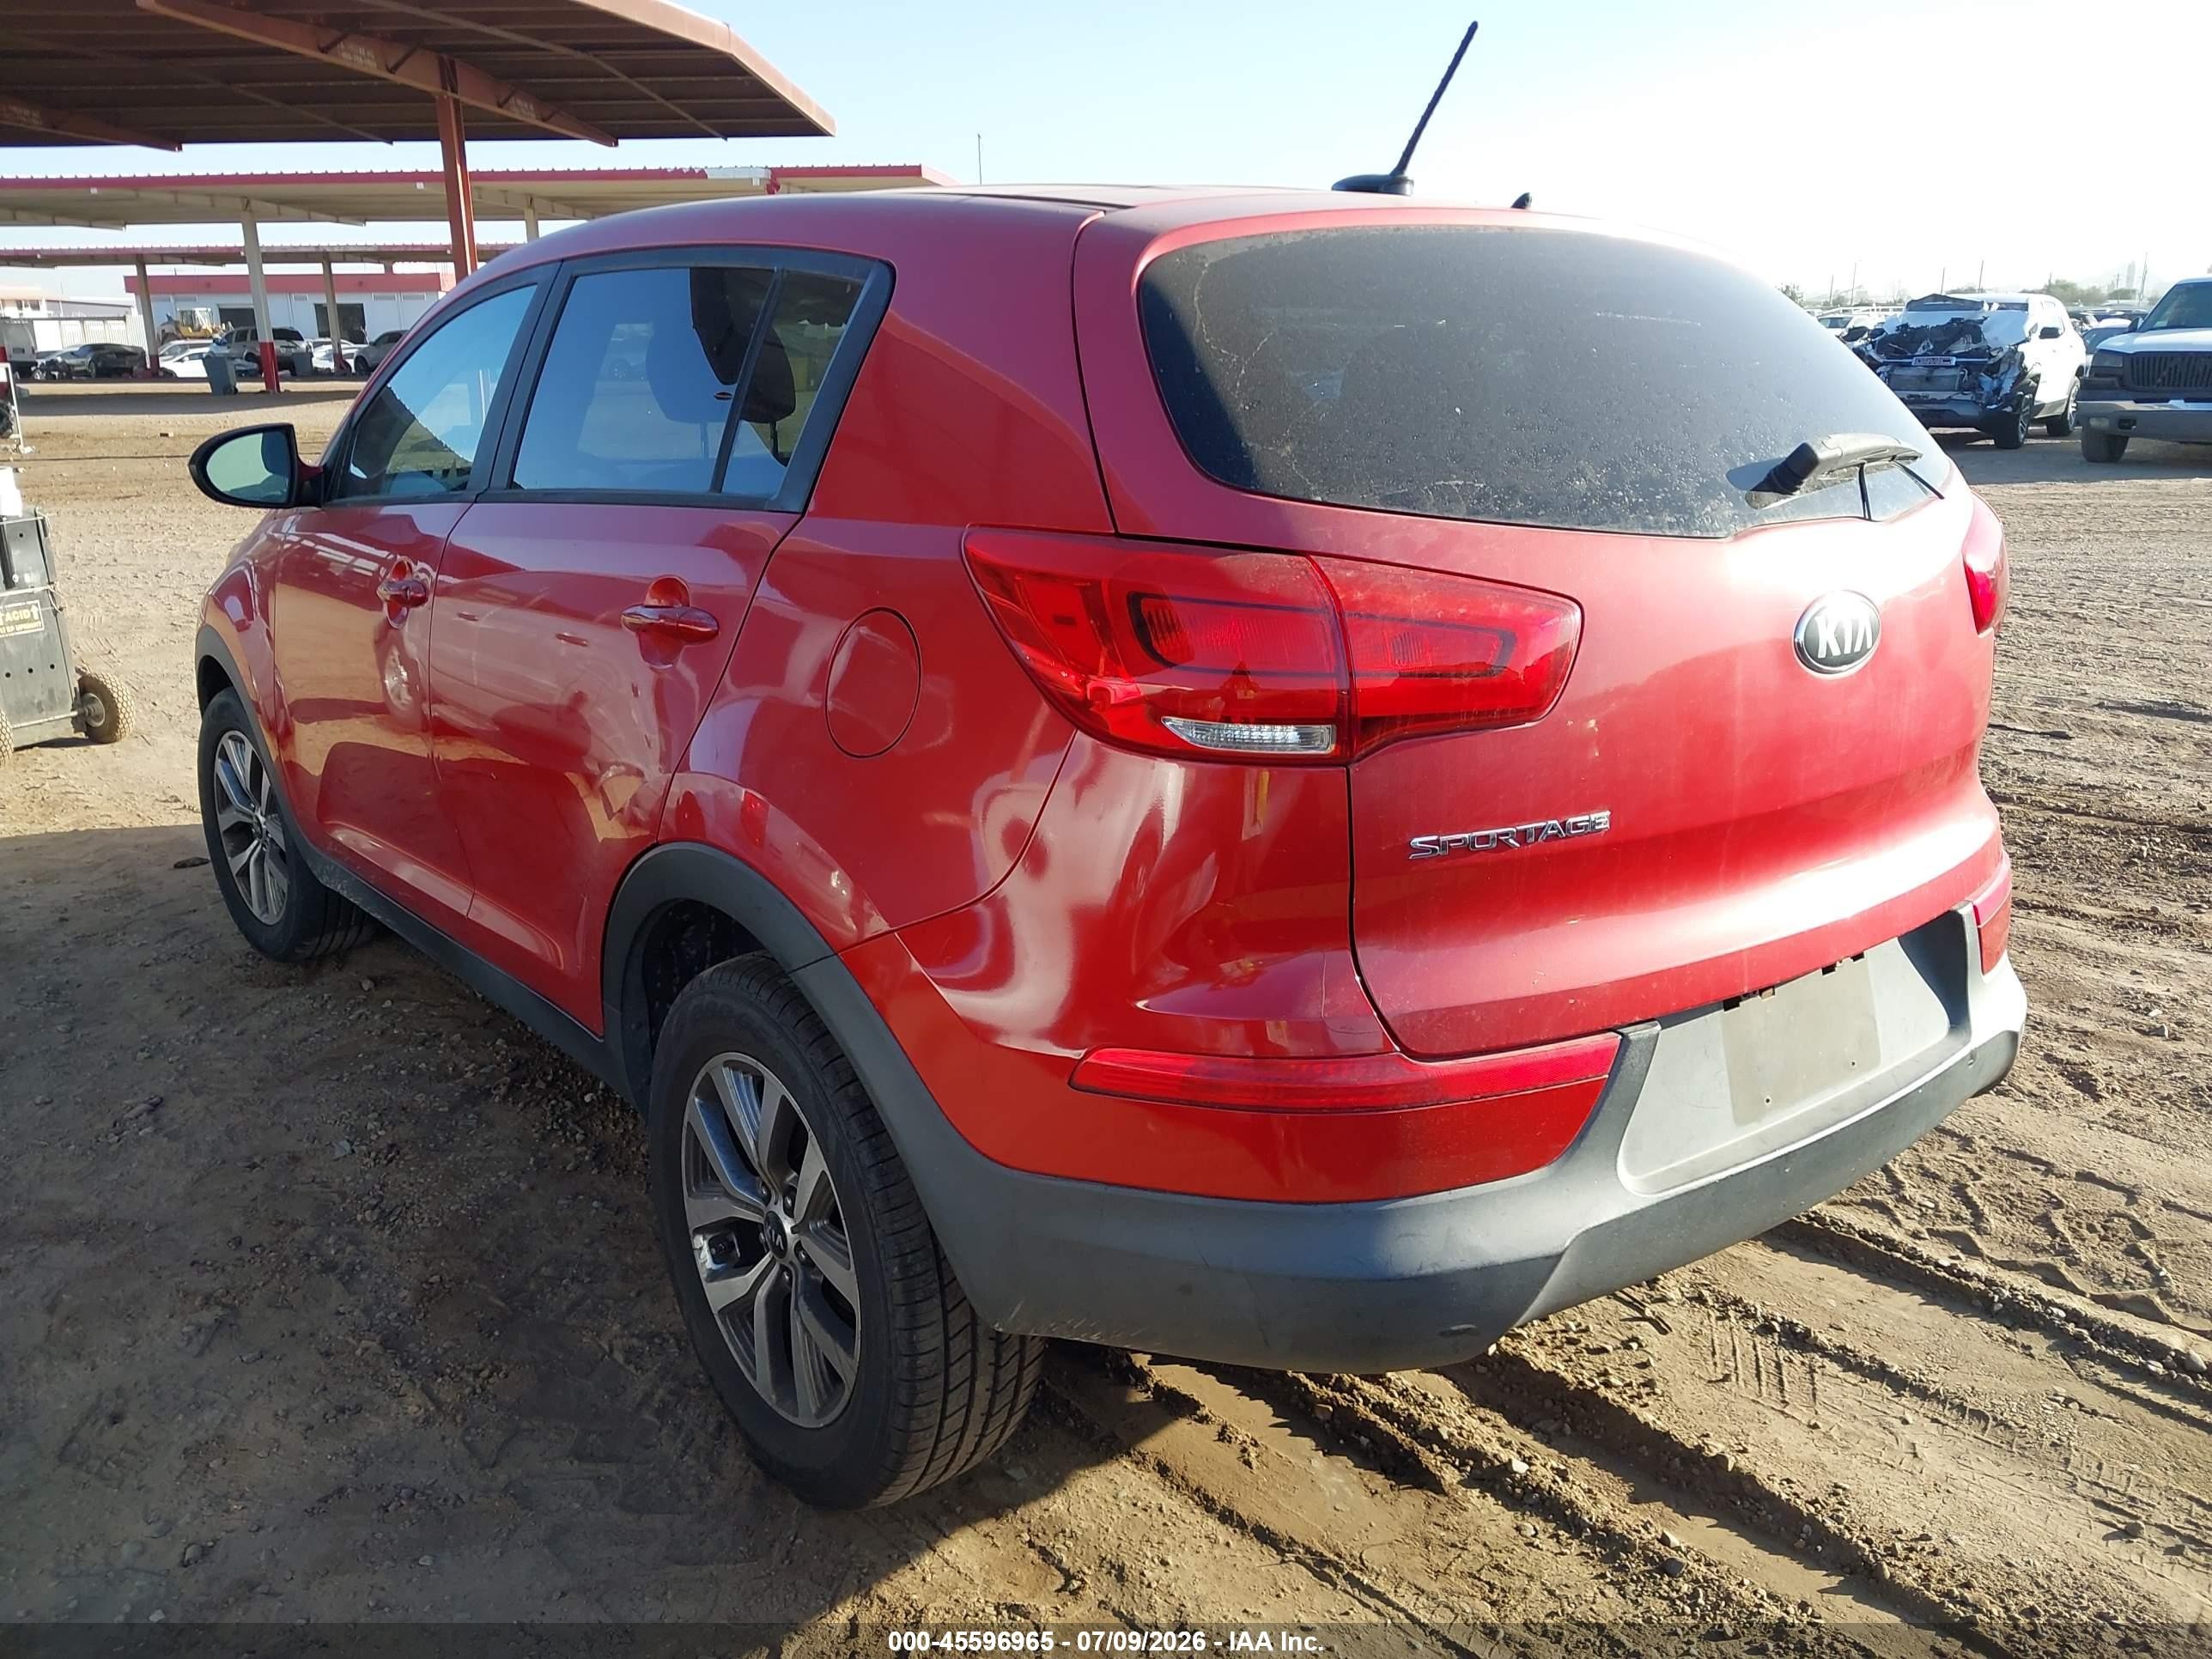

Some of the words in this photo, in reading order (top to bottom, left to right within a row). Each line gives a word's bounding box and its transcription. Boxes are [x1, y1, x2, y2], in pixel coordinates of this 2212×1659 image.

[5, 609, 31, 623] ACID
[1814, 609, 1873, 659] KIA
[1408, 810, 1612, 860] SPORTAGE
